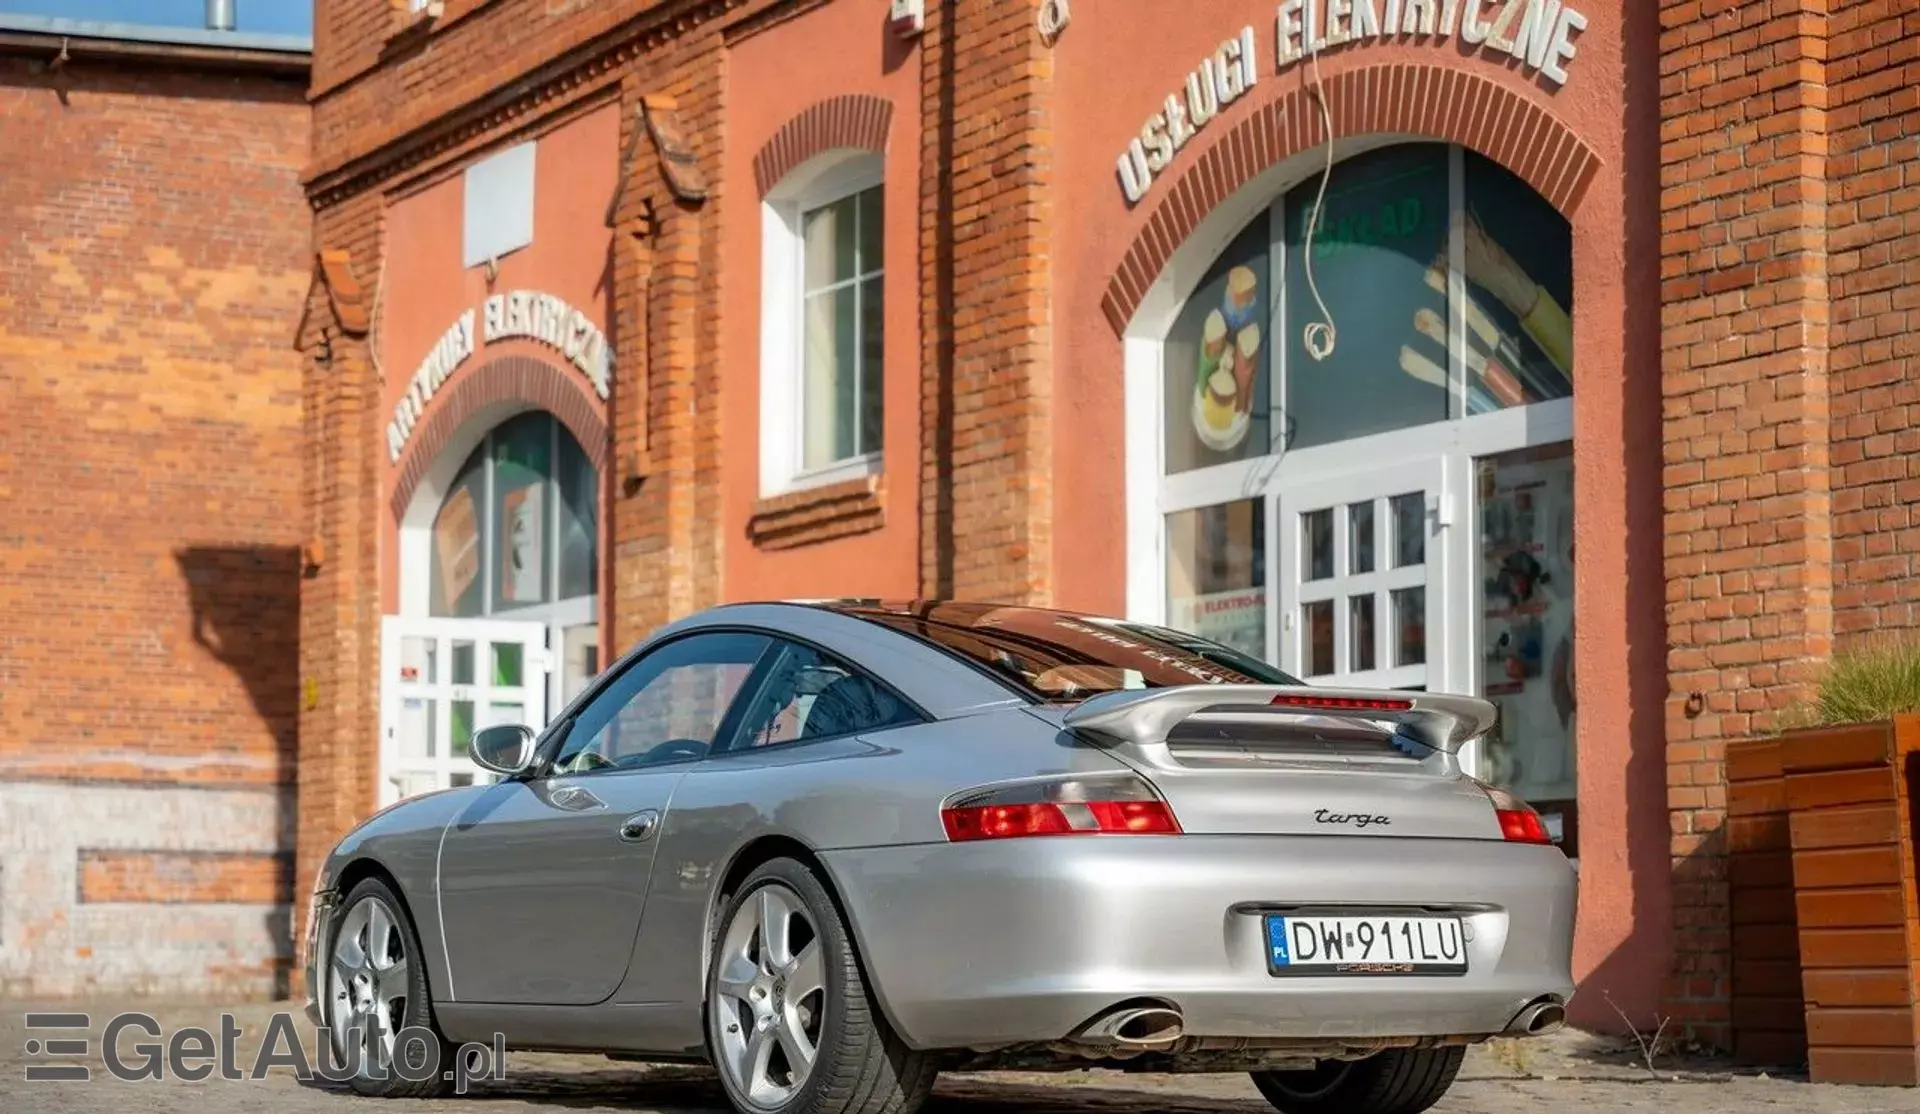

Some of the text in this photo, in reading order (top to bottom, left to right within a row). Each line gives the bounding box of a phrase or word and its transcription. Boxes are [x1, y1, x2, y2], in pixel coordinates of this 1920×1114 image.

[1117, 25, 1258, 203] USŁUGI
[1313, 808, 1391, 828] targa
[1273, 946, 1288, 958] PL
[1292, 921, 1458, 961] DW 911LU
